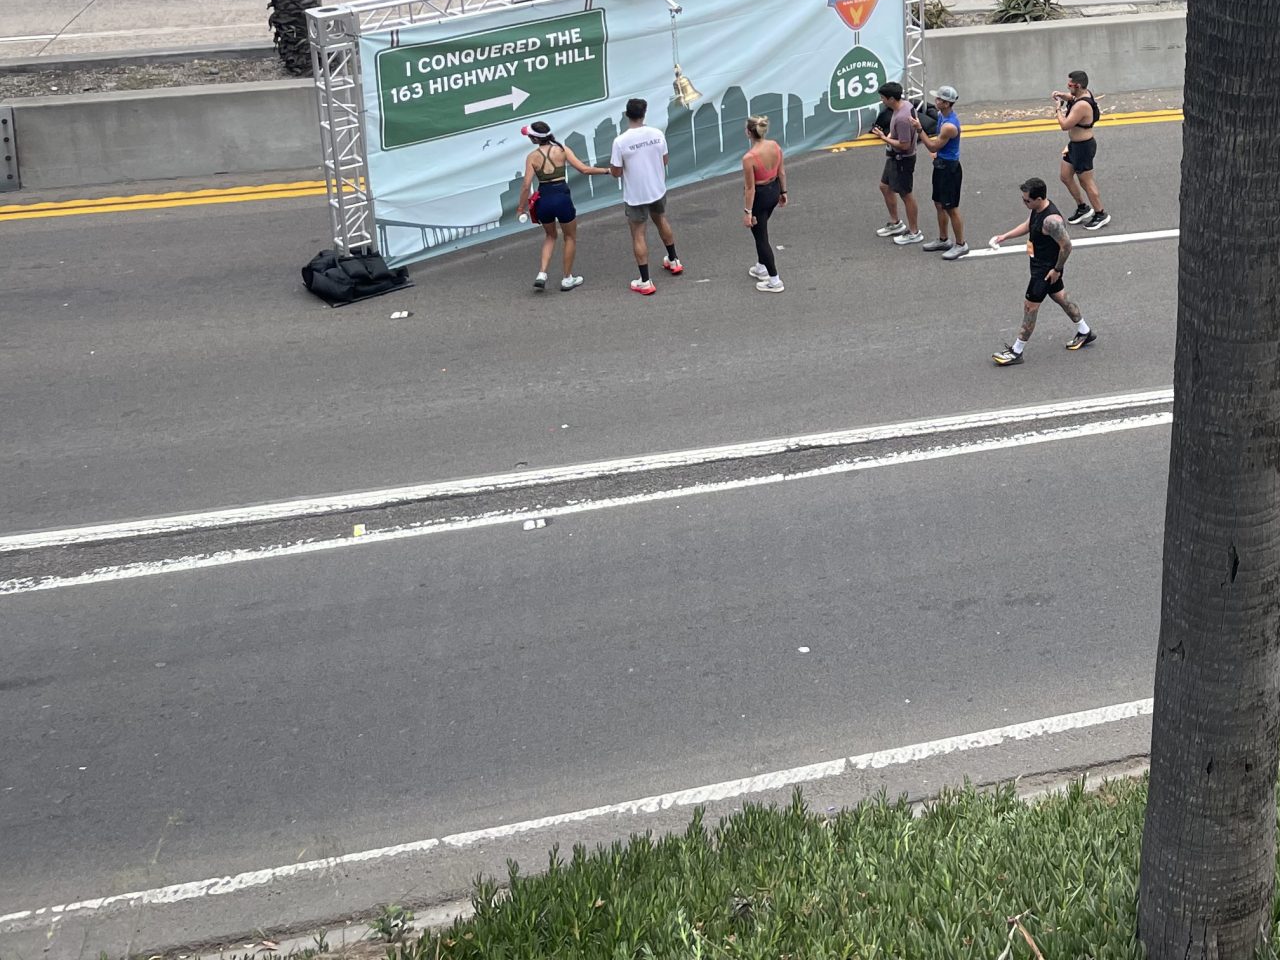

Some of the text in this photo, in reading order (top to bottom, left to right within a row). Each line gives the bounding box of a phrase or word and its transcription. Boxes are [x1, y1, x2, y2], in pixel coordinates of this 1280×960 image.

[405, 28, 582, 77] I CONQUERED THE
[836, 61, 879, 76] CALIFORNIA
[390, 46, 596, 104] 163 HIGHWAY TO HILL
[837, 72, 879, 100] 163
